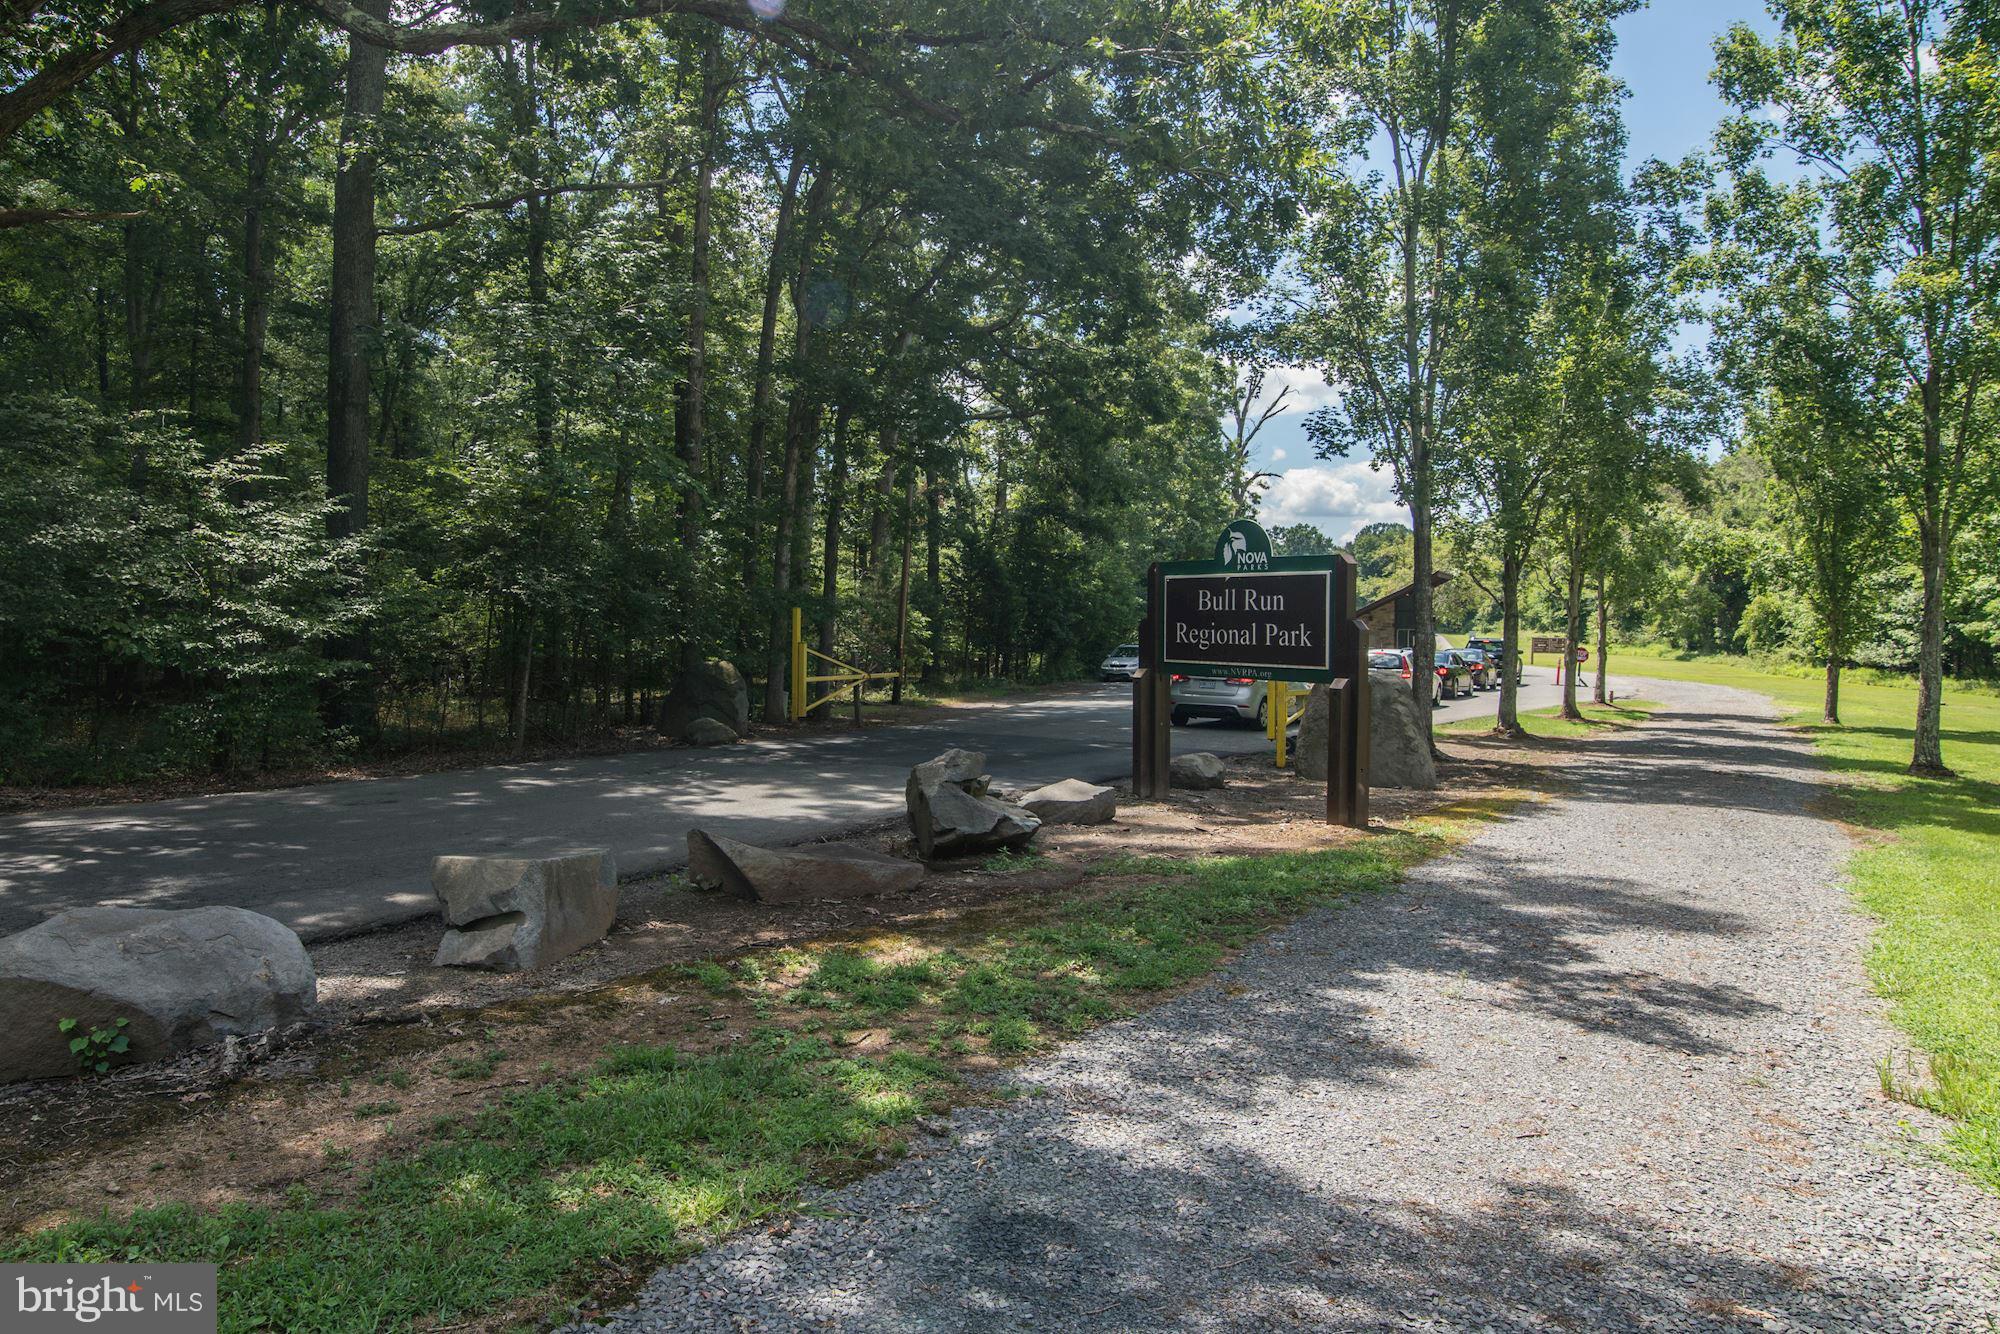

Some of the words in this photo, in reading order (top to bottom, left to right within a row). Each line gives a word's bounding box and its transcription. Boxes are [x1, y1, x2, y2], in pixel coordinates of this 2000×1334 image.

[1237, 552, 1268, 564] NOVA
[1198, 588, 1236, 611] Bull
[1244, 588, 1284, 611] Run
[1175, 622, 1257, 650] Regional
[1265, 623, 1312, 647] Park
[1211, 668, 1272, 678] www.NVRPA.org
